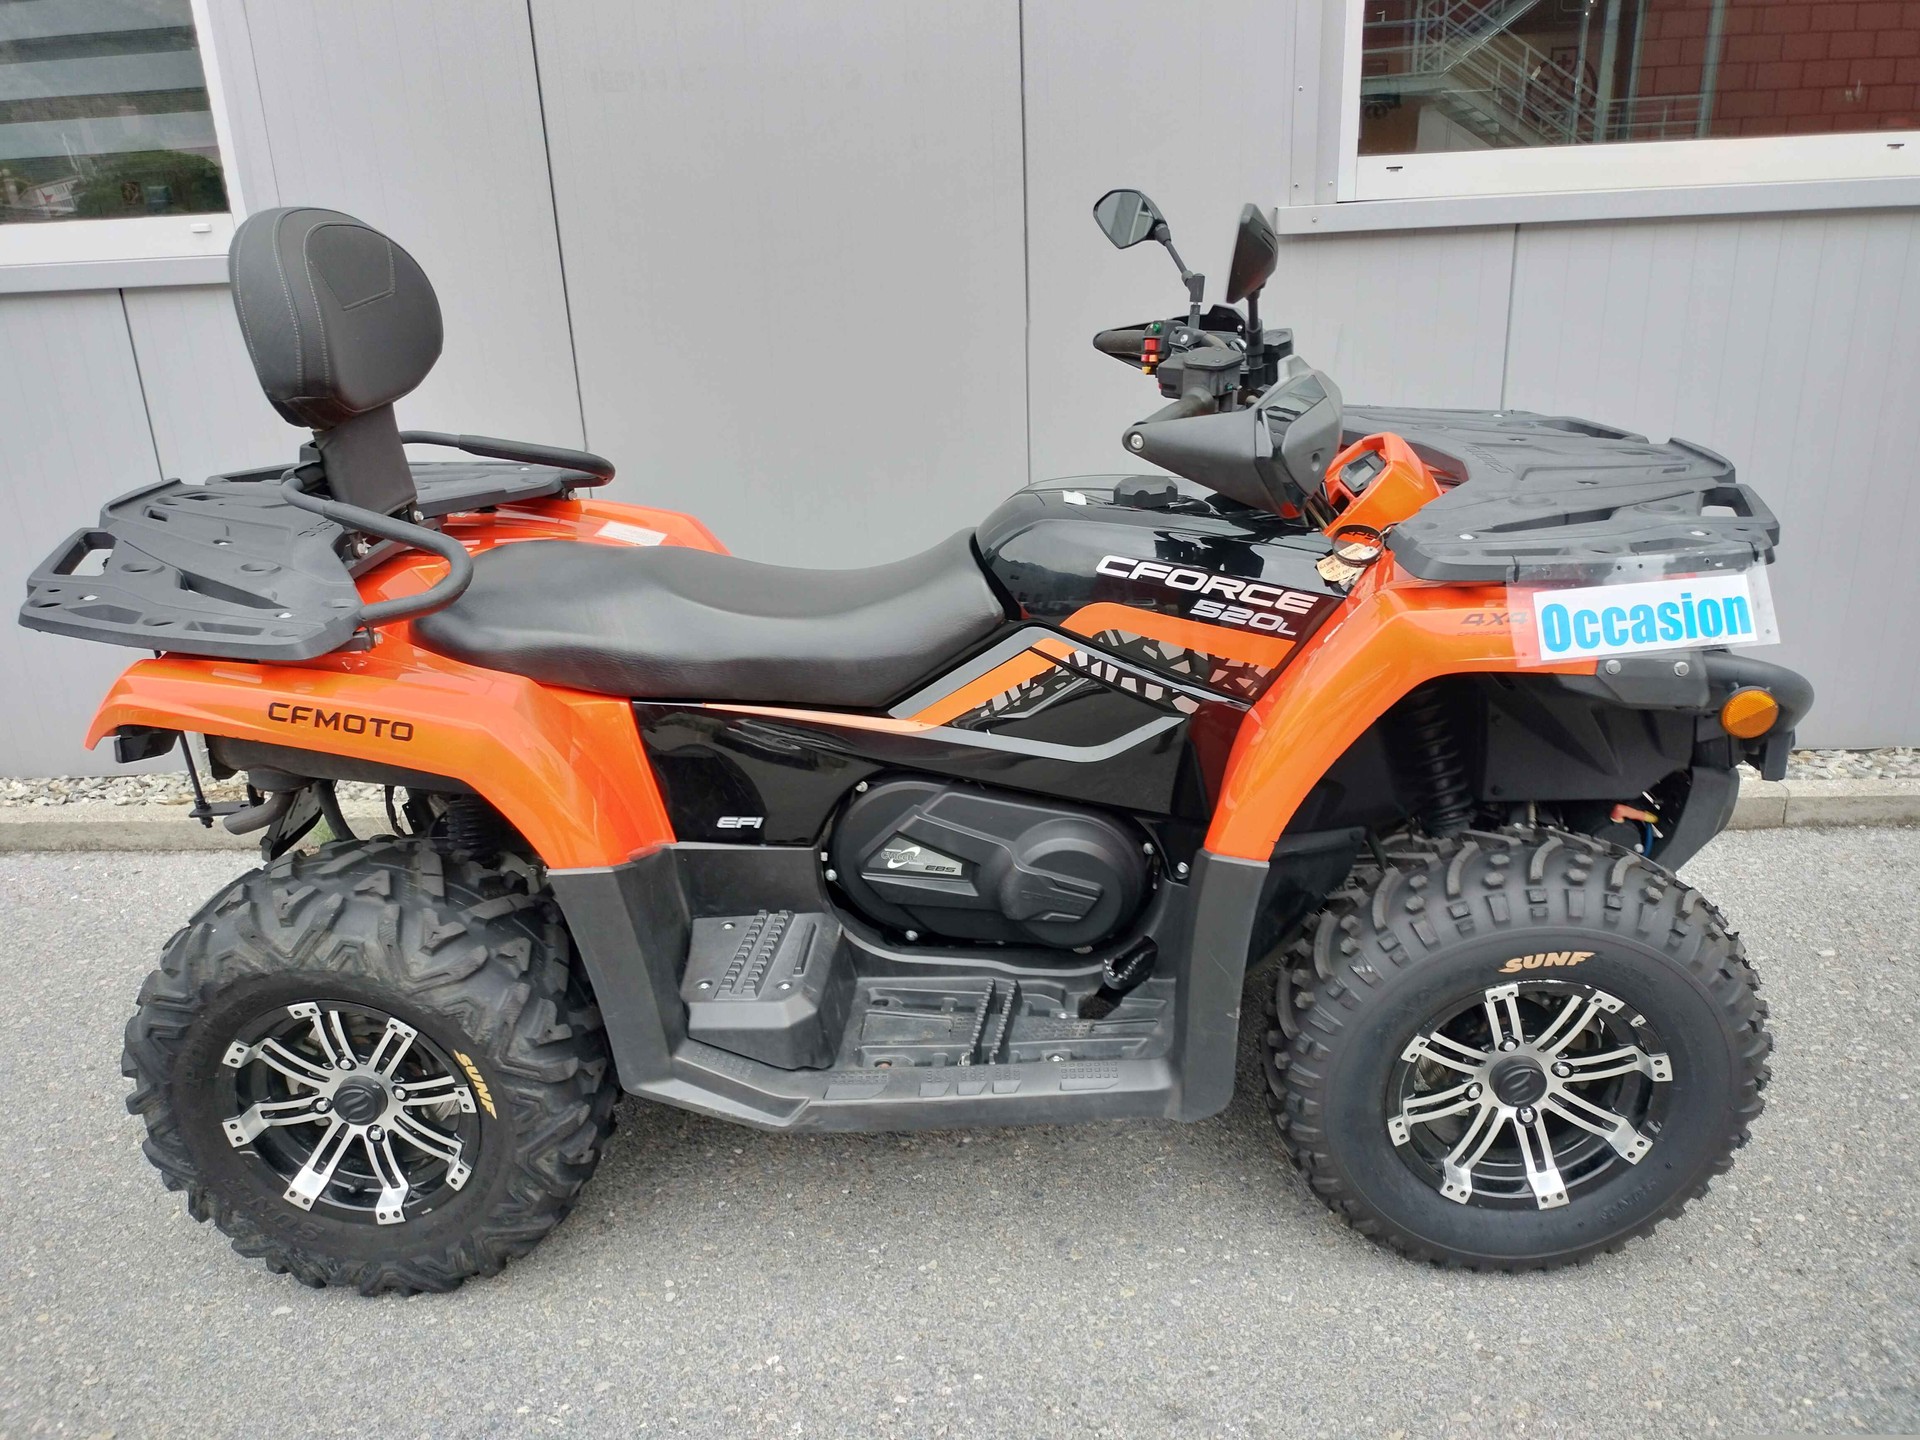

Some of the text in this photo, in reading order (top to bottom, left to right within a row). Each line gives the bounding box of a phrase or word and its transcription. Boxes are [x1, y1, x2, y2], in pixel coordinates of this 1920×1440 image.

[1095, 555, 1318, 615] CFORCE
[1190, 599, 1296, 636] 520L
[1541, 592, 1751, 652] Occasion
[268, 702, 414, 742] CFMOTO
[716, 816, 764, 829] EFI
[925, 865, 956, 873] EBS
[1498, 951, 1596, 973] SUNF
[453, 1049, 497, 1120] SUNF
